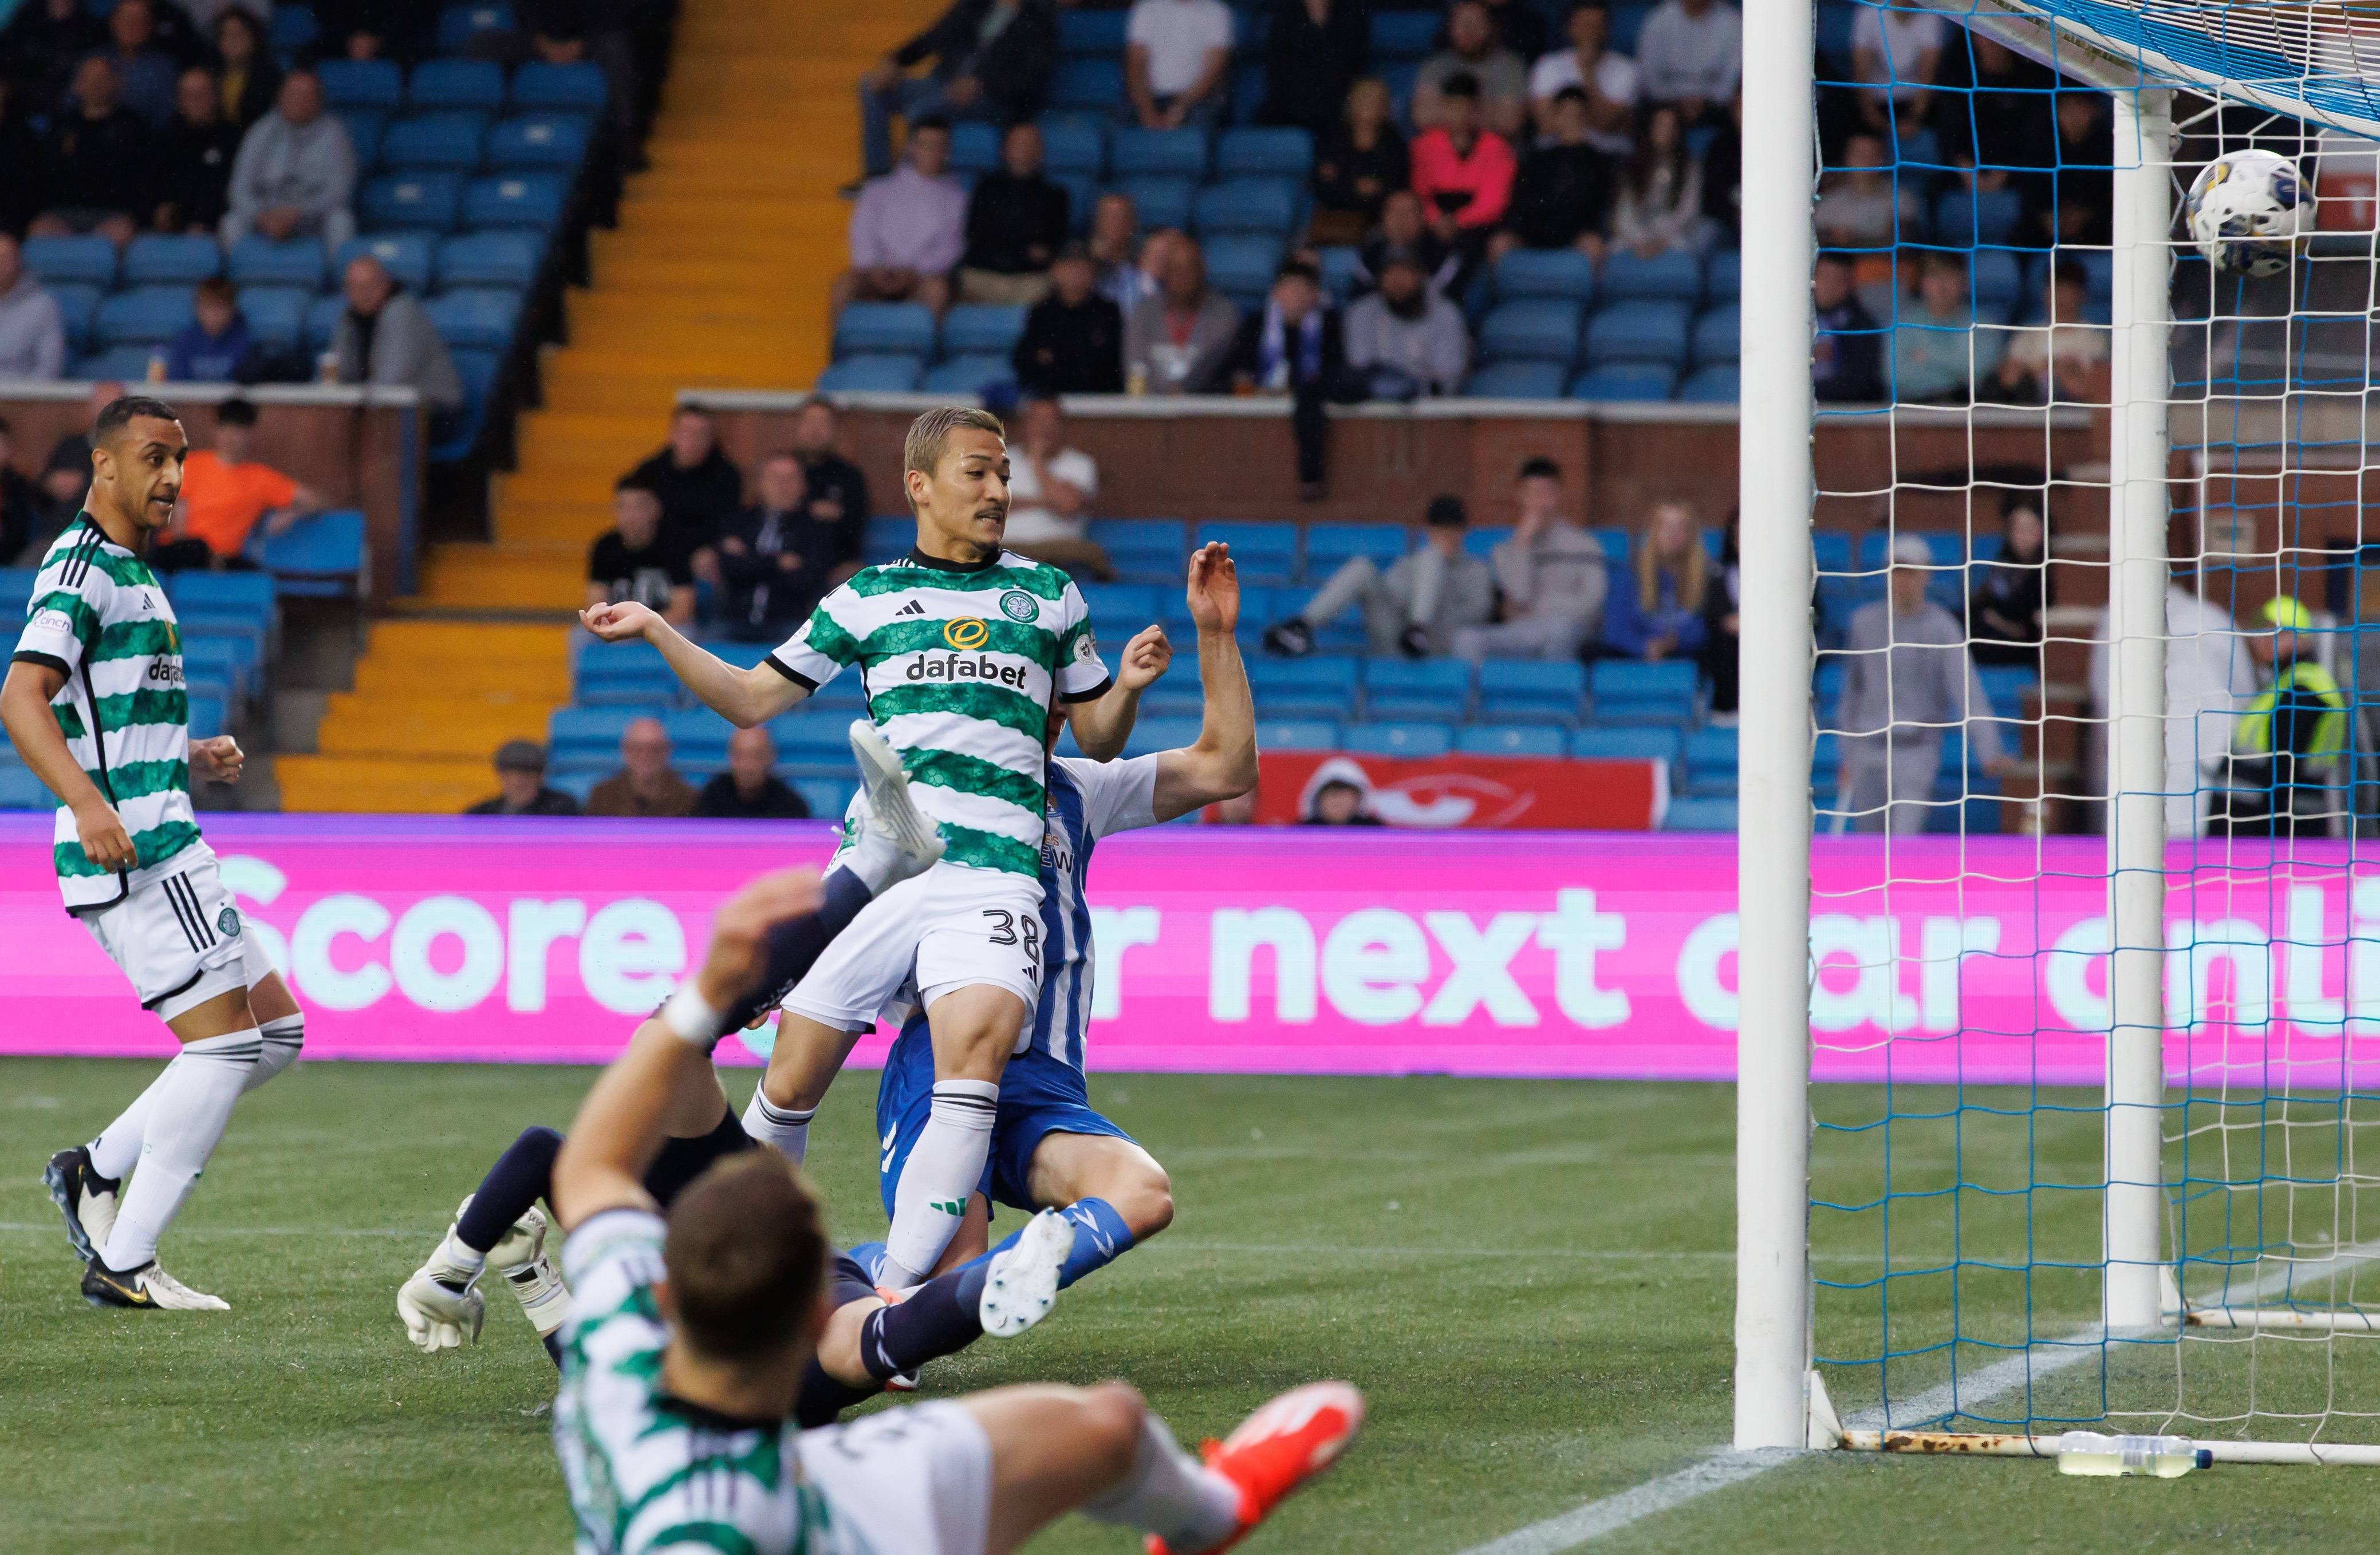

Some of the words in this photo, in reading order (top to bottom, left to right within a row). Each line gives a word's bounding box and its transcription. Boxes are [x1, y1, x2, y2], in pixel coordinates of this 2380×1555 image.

[41, 617, 70, 632] cinch
[906, 653, 1027, 689] dafabet
[983, 909, 1039, 965] 38
[1209, 887, 1631, 1029] next
[1676, 913, 2000, 1031] car
